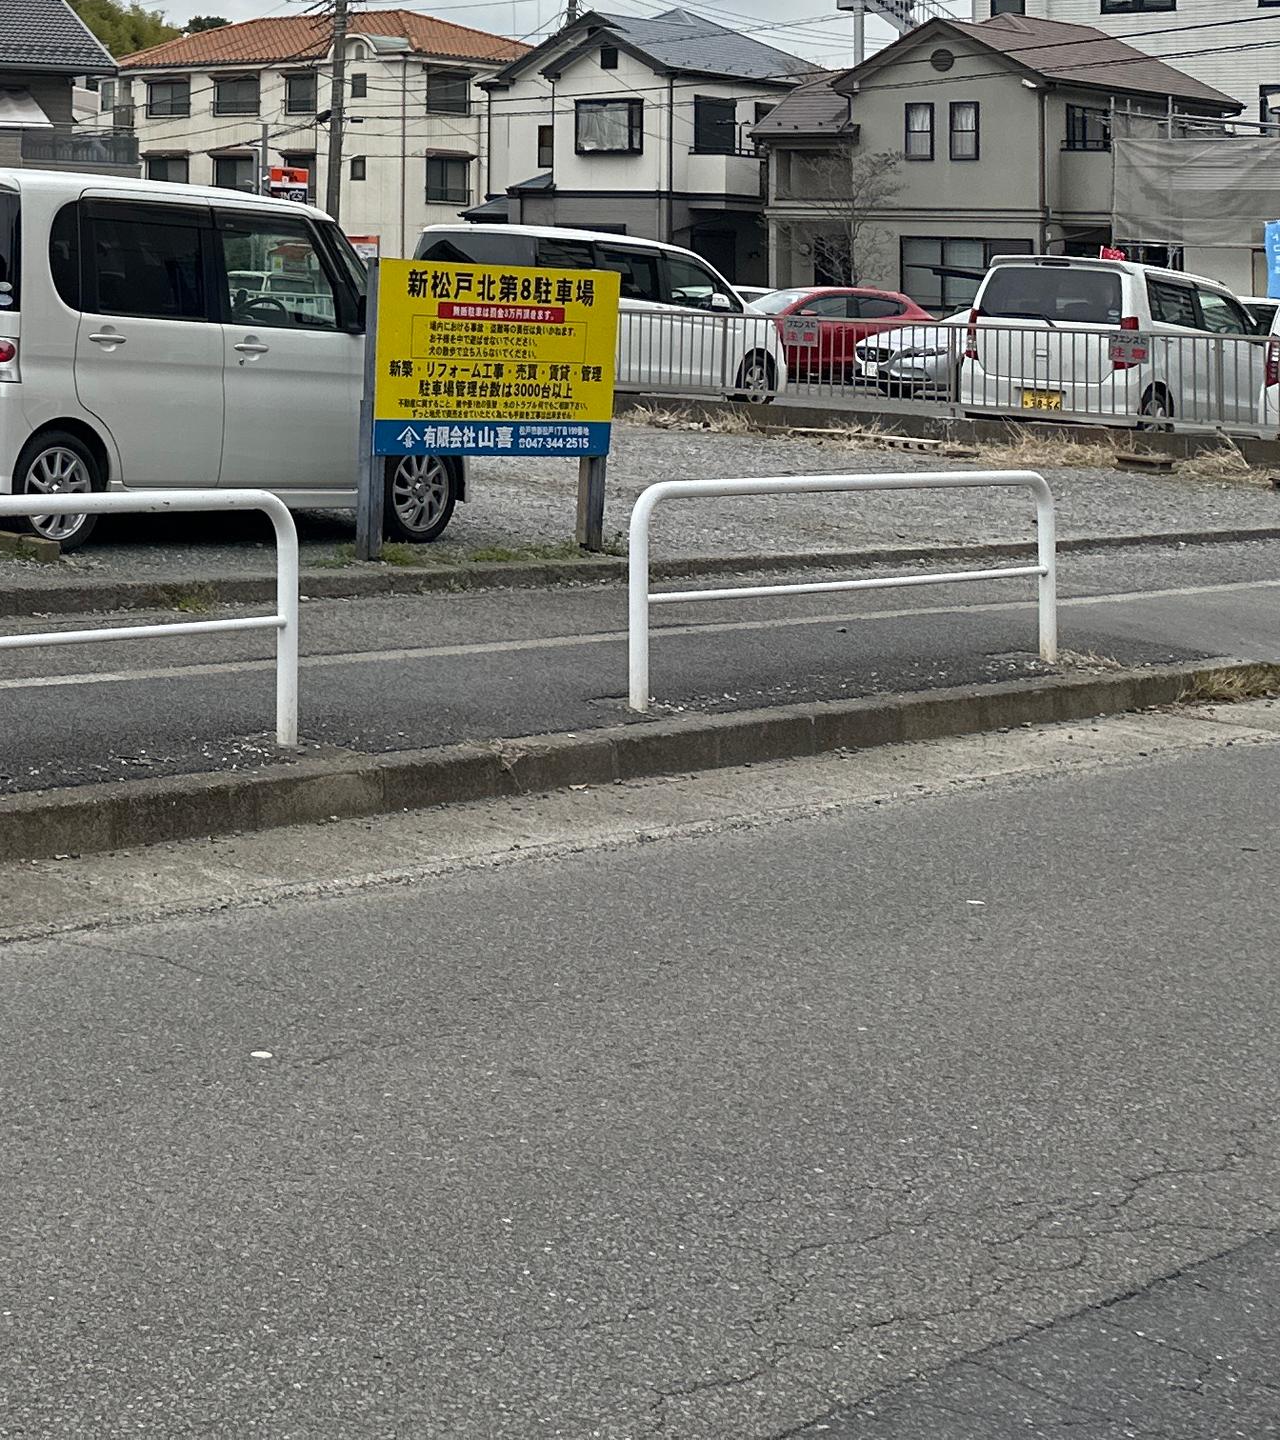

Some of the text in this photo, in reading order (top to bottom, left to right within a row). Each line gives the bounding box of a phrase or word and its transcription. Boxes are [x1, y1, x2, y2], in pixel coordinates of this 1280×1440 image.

[407, 268, 595, 307] 新松戸北第8駐車場
[418, 380, 573, 399] 駐車場管理台数は3000台以上
[423, 425, 514, 449] 有限会社山喜
[525, 437, 590, 449] 047-344-2515
